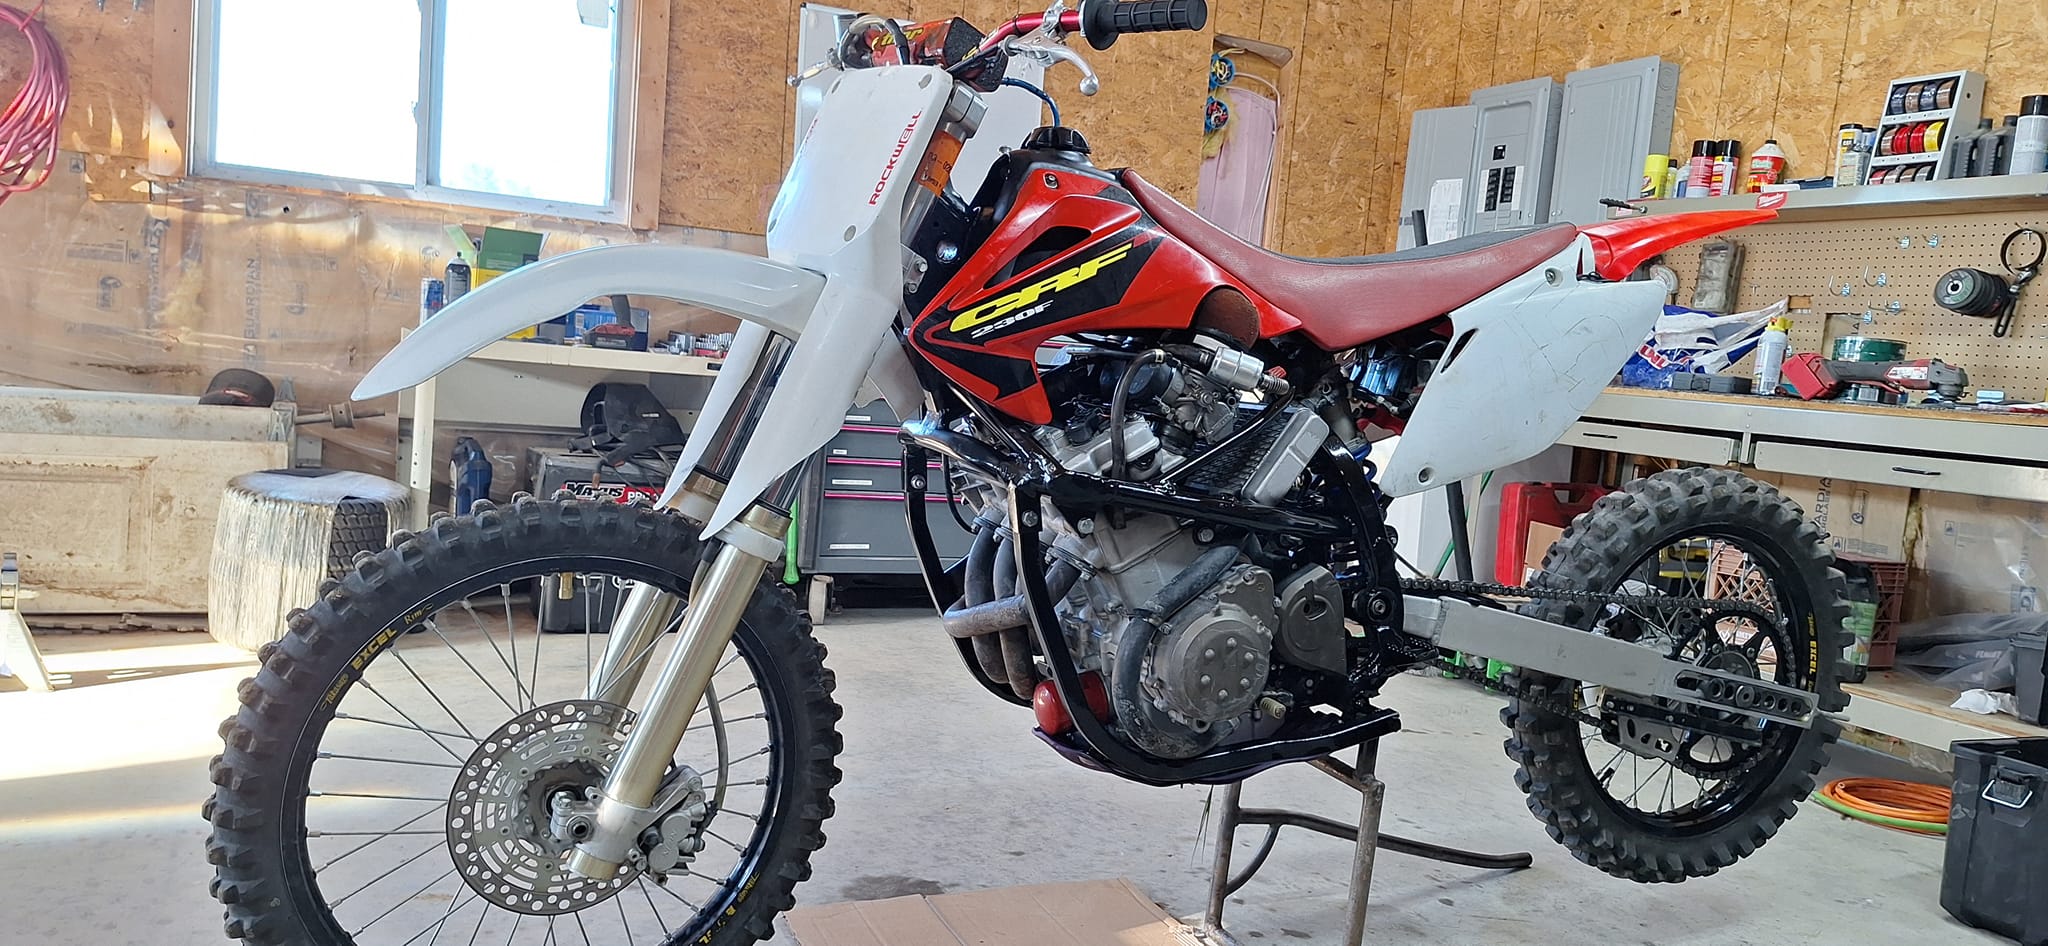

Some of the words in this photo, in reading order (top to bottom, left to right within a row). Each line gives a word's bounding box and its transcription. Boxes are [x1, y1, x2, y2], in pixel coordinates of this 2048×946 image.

[868, 110, 923, 206] ROCKWELL
[950, 242, 1132, 332] CRF
[971, 299, 1054, 339] 230F
[351, 628, 397, 670] EXCEL
[1809, 641, 1817, 675] EXCEL
